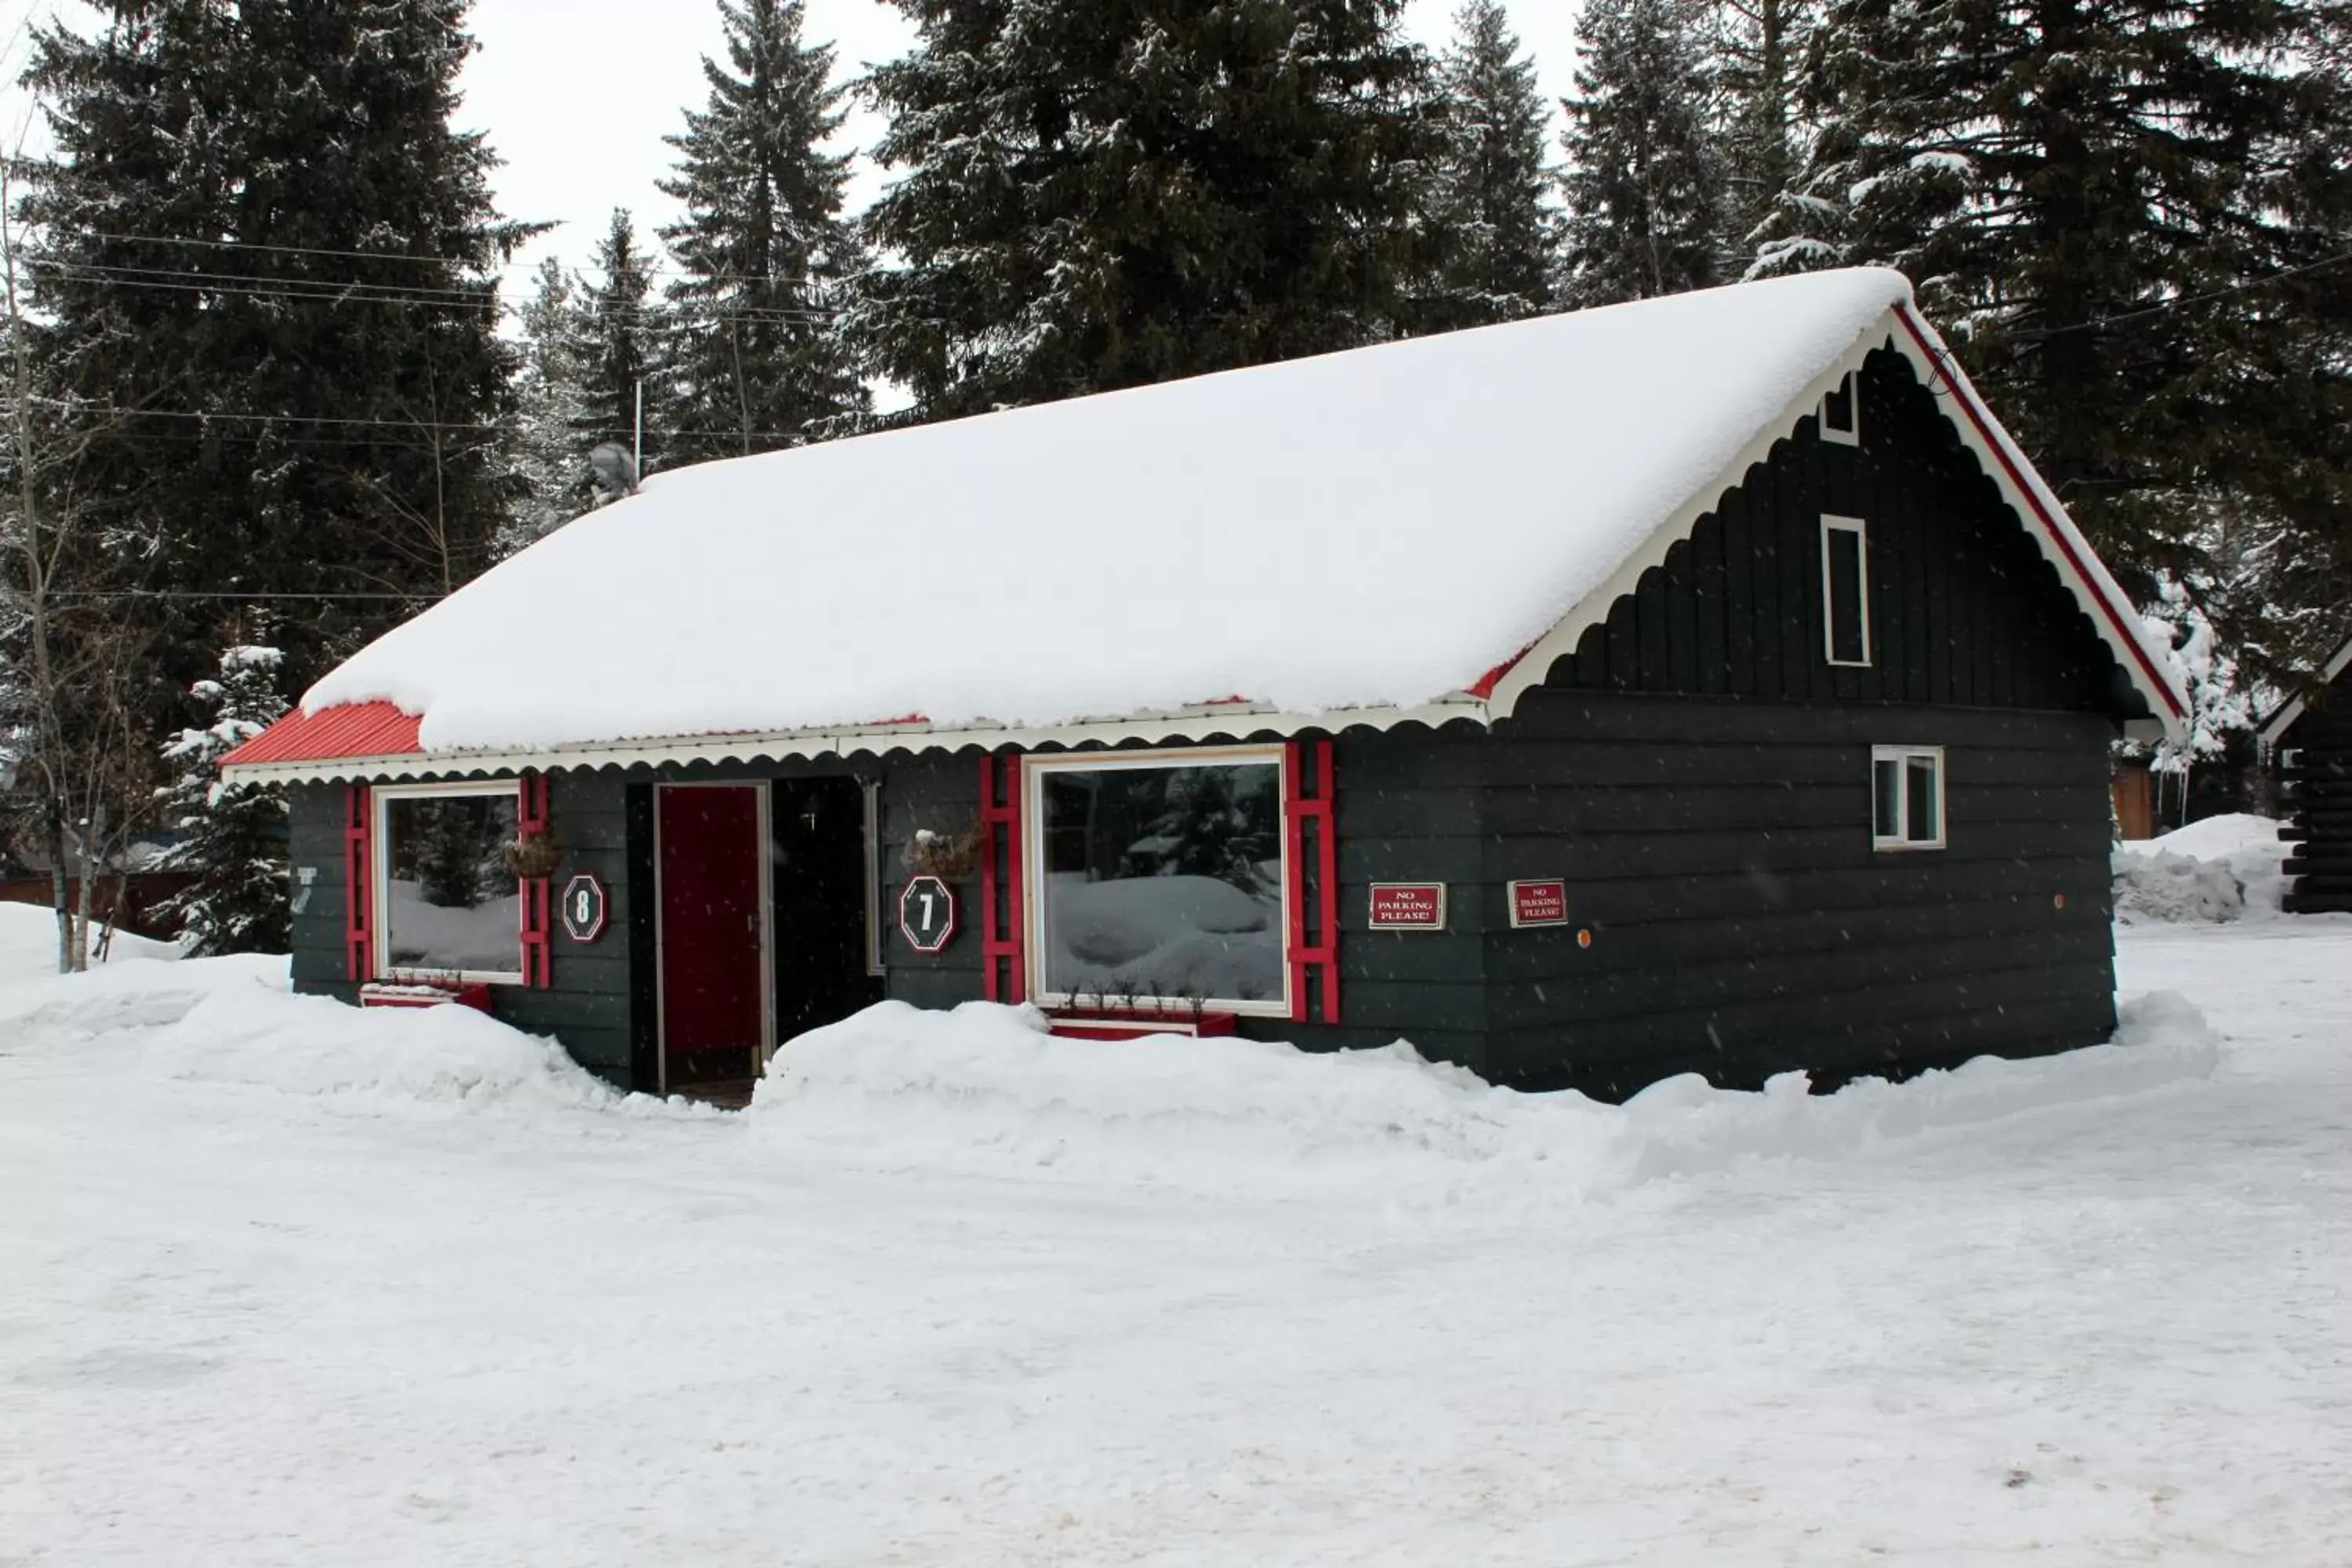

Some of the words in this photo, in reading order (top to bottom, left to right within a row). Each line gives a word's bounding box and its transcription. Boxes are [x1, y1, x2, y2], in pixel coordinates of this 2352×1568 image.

[576, 890, 589, 923] 8
[1533, 888, 1546, 897] NO
[920, 895, 933, 931] 7
